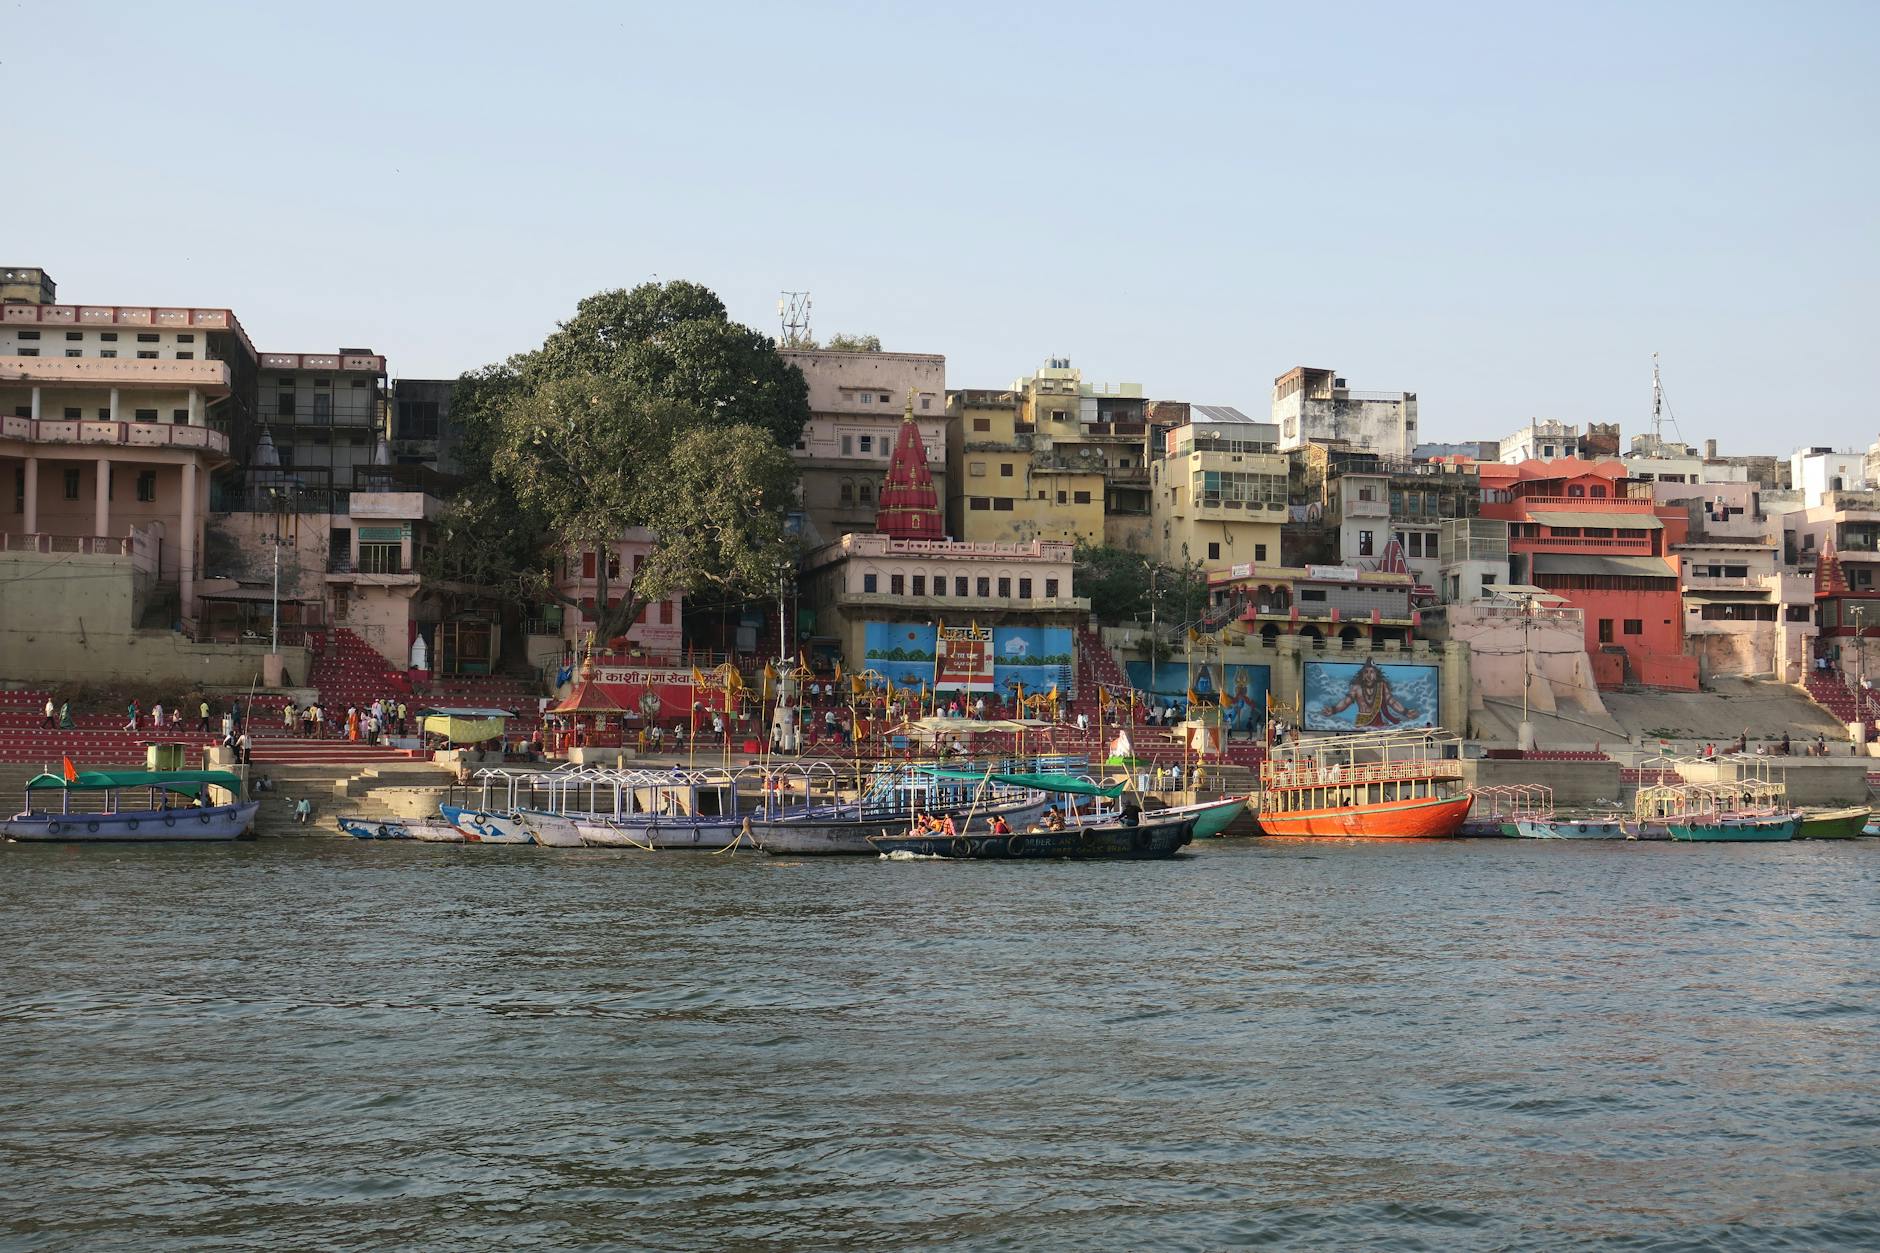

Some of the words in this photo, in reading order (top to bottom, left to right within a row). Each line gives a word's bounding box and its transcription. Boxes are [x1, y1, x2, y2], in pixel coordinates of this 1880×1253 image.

[605, 671, 640, 684] काशी
[641, 672, 665, 683] गगा
[666, 671, 690, 684] सेवा
